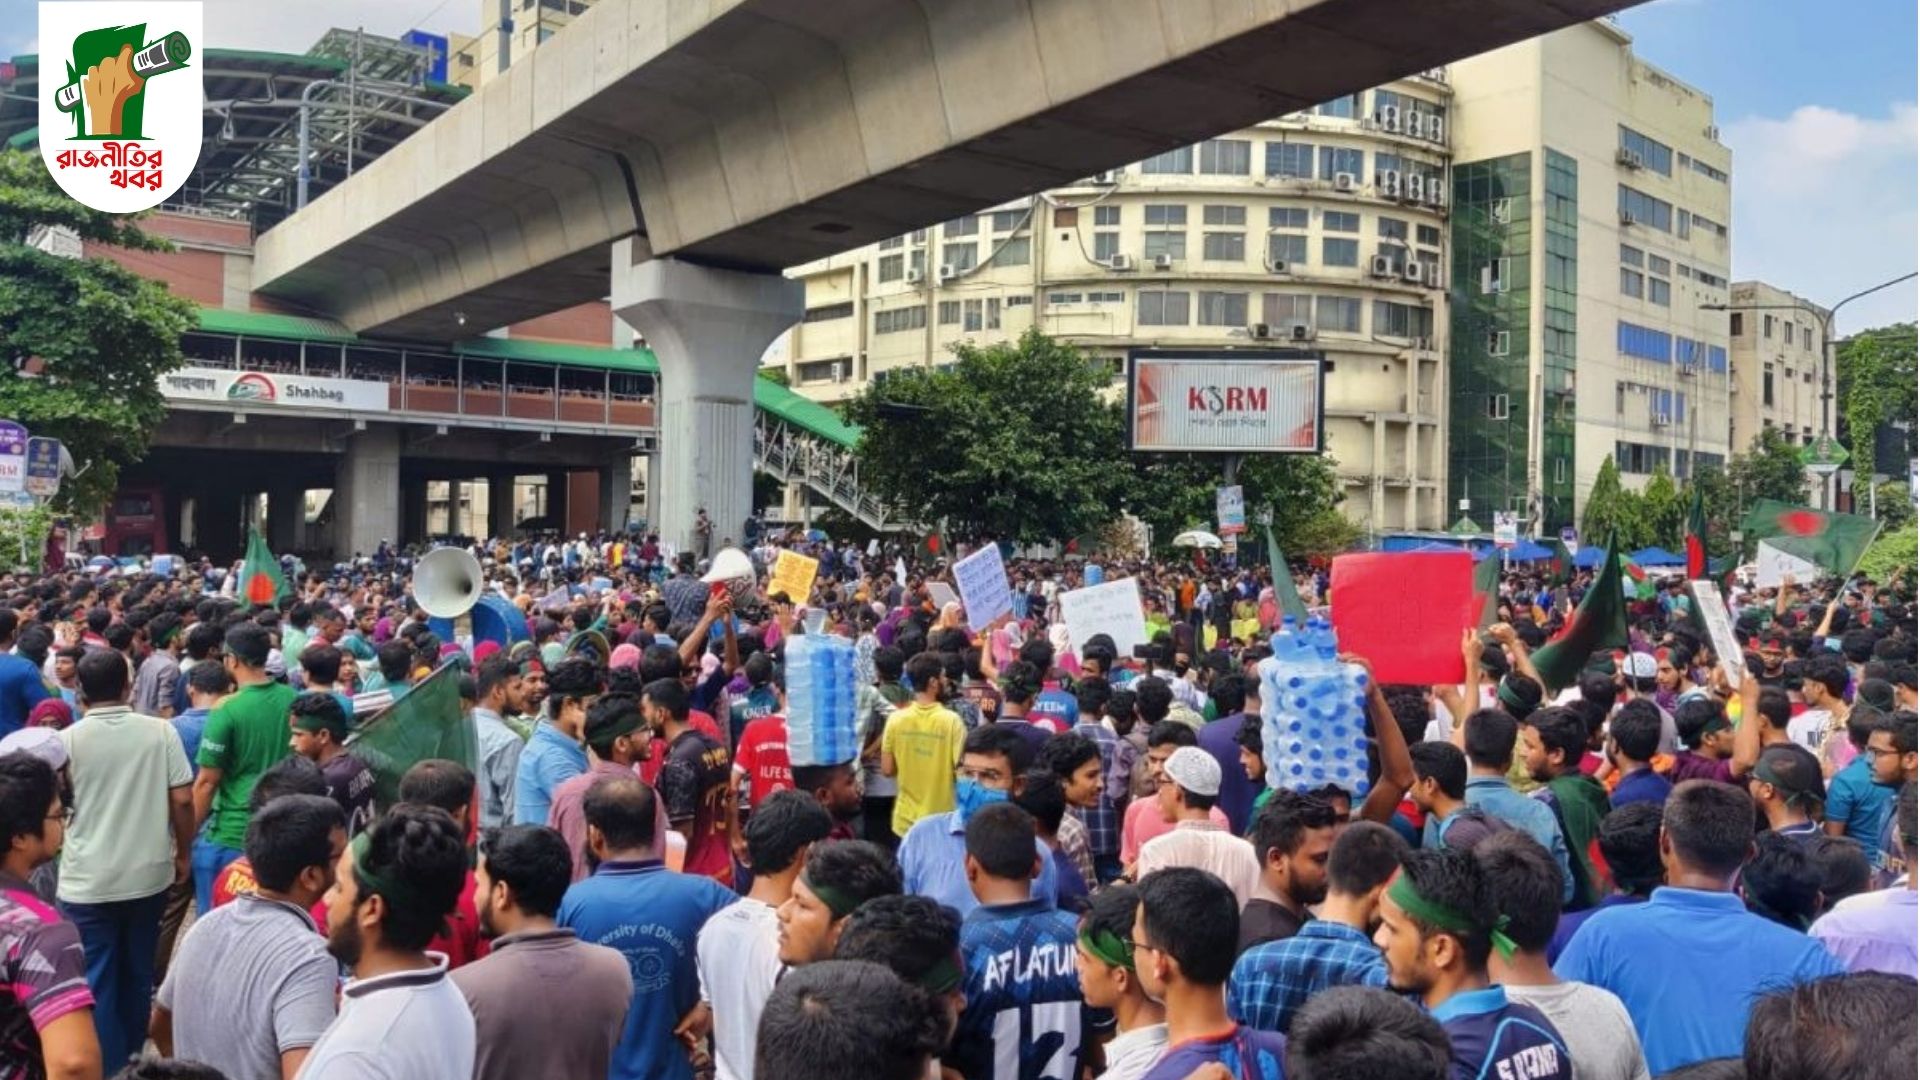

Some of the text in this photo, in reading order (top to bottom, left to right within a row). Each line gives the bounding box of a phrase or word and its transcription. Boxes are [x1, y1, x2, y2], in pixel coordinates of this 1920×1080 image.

[286, 384, 344, 402] Shahbag
[1188, 386, 1267, 415] KSRM
[640, 923, 656, 936] of
